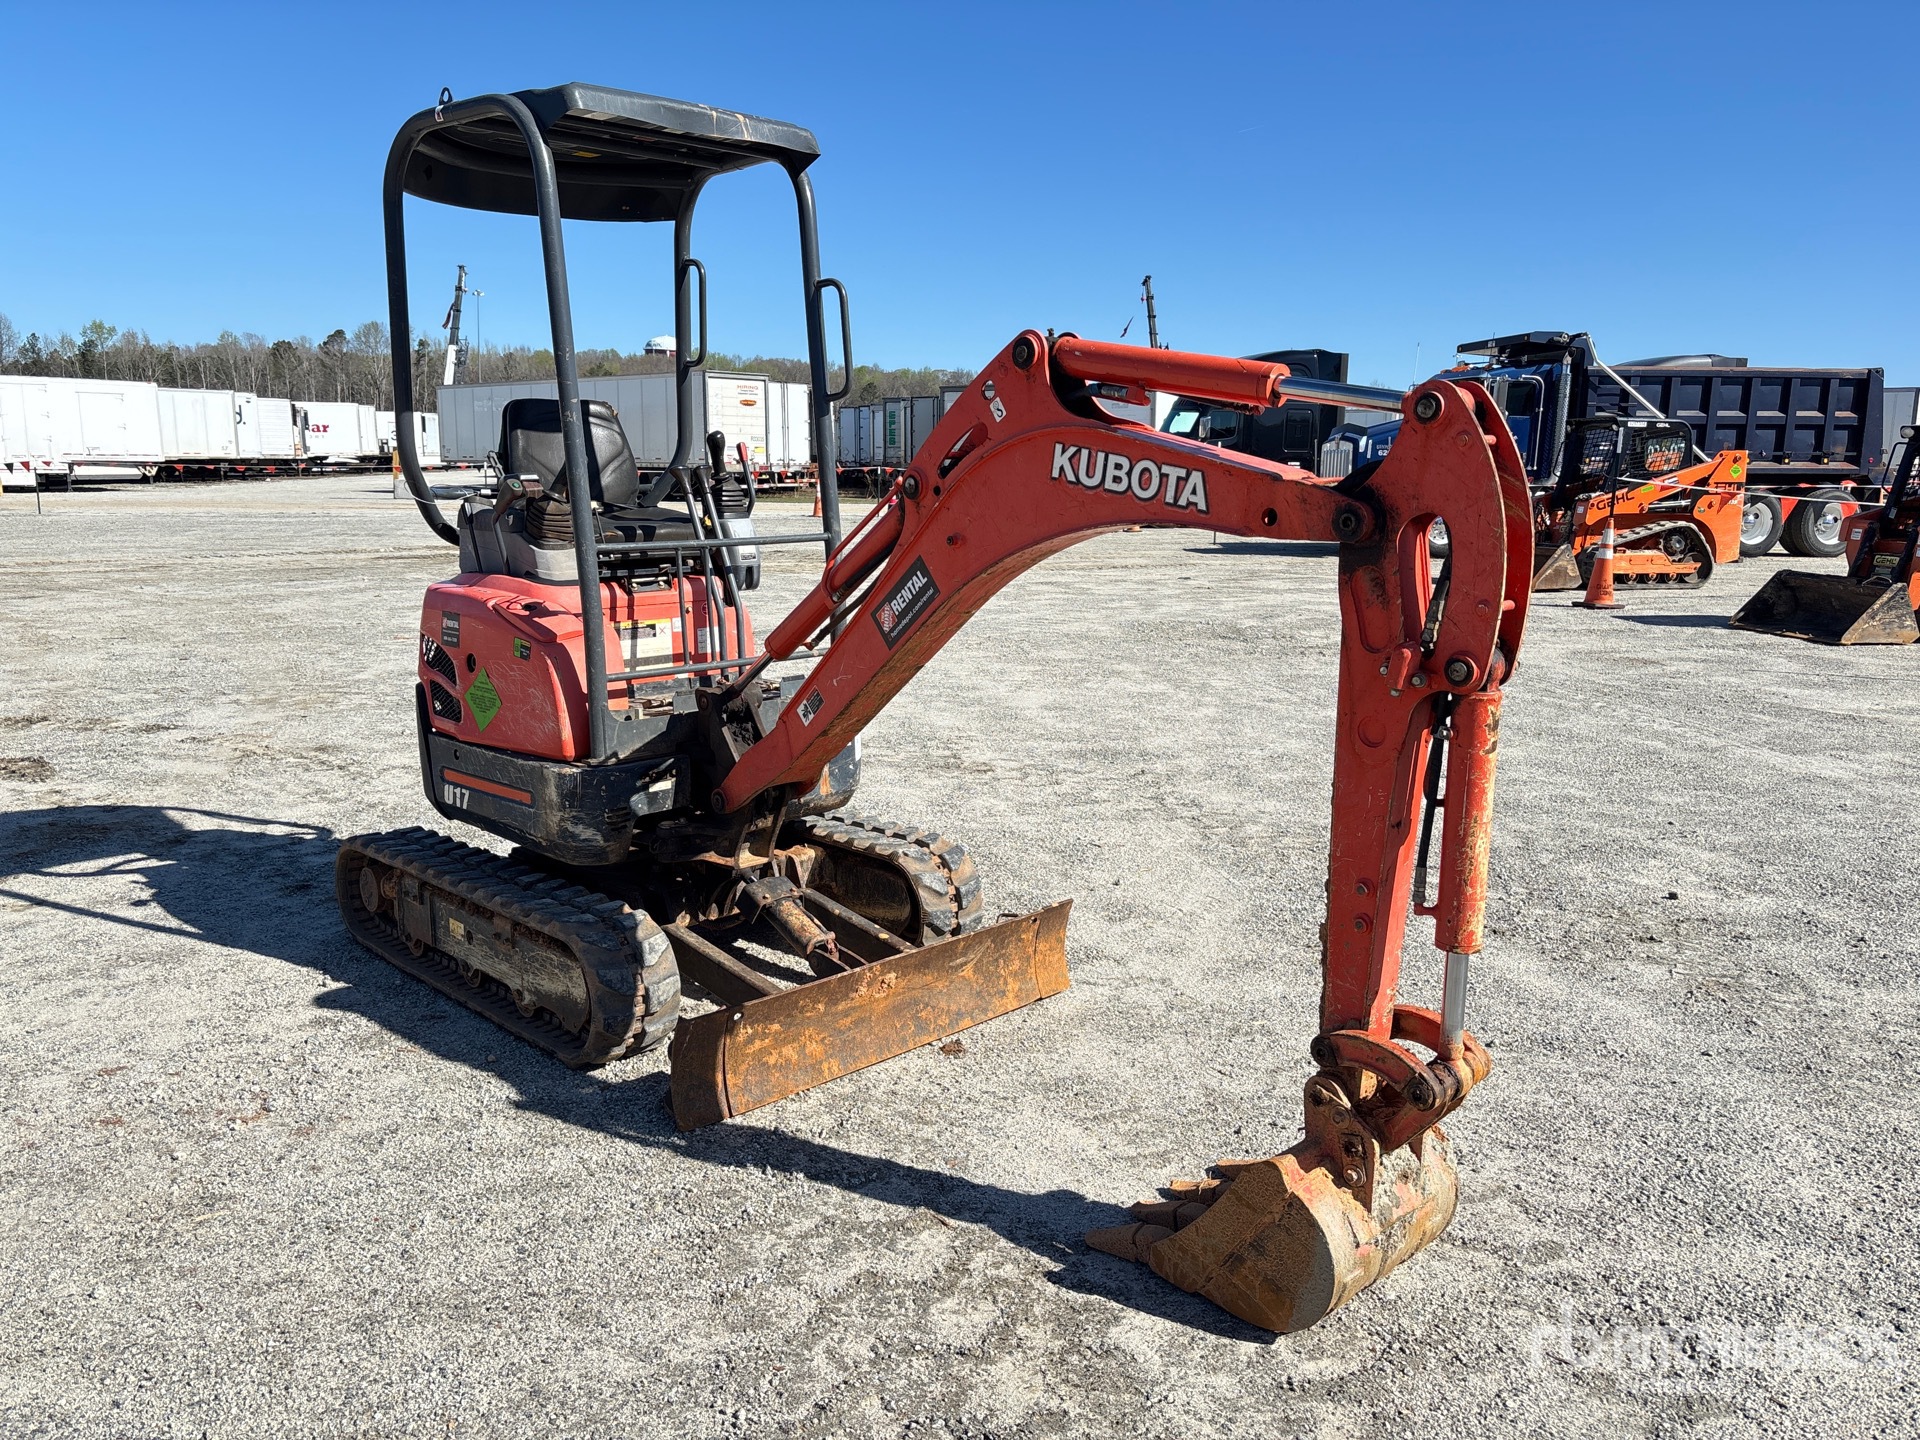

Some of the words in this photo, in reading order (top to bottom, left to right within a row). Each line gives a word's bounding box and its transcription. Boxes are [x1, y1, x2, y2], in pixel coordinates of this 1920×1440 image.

[1051, 442, 1208, 513] KUBOTA
[1875, 556, 1897, 565] GEHL
[890, 570, 928, 616] RENTAL
[890, 586, 935, 638] homedepot.com/rental
[444, 784, 470, 810] U17
